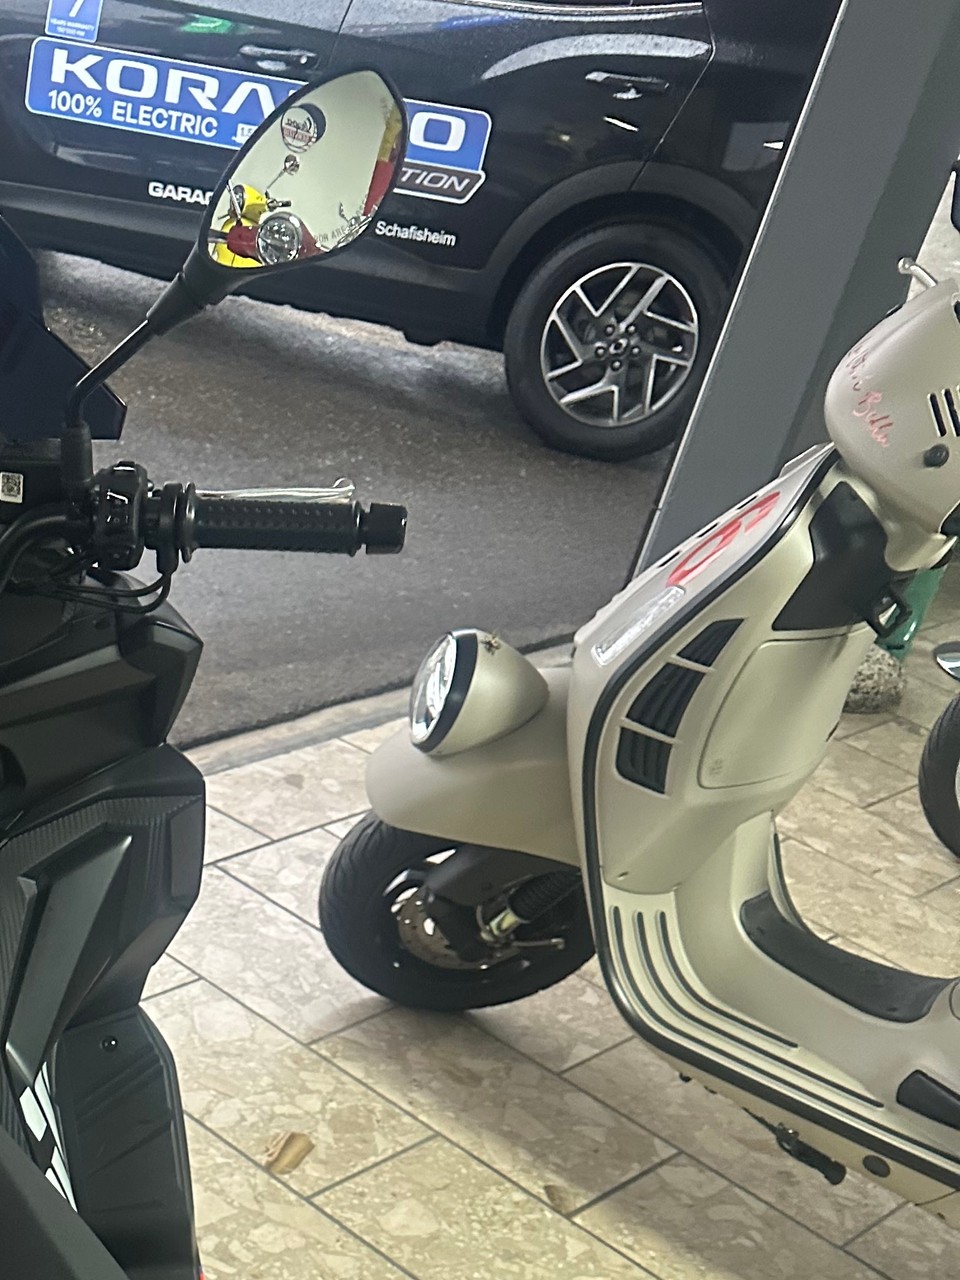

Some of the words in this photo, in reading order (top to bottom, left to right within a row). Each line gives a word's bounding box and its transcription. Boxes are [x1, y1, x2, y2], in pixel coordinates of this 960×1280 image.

[48, 90, 103, 118] 100%
[112, 101, 219, 138] ELECTRIC
[401, 168, 470, 192] TION
[375, 221, 457, 247] Schafisheim
